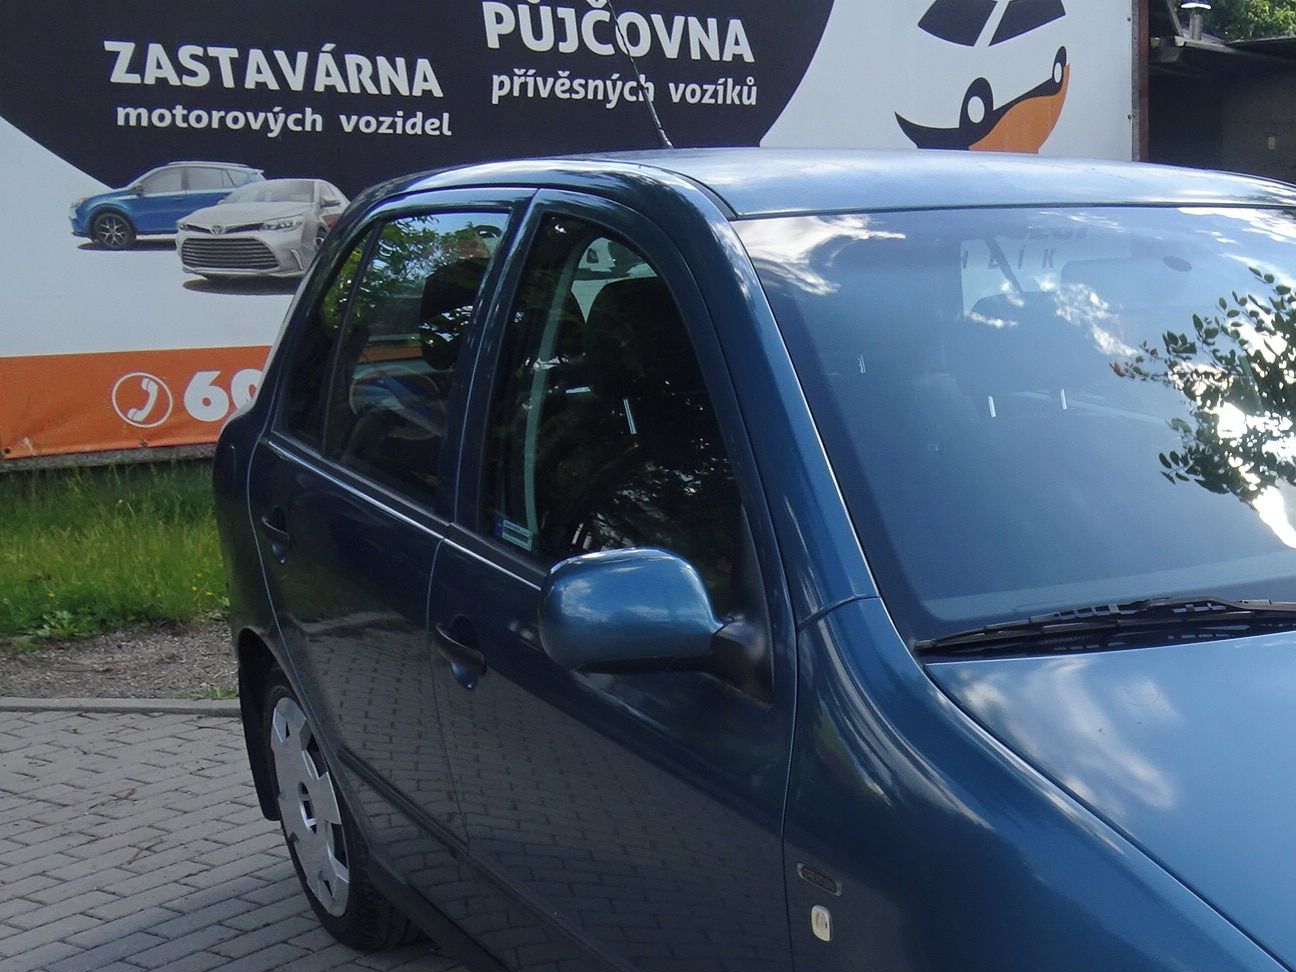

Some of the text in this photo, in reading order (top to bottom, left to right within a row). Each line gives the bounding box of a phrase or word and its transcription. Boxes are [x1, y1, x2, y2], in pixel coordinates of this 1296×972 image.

[104, 41, 443, 97] ZASTAVÁRNA
[491, 68, 757, 108] přívěsných vozíků
[117, 105, 452, 138] motorových vozidel
